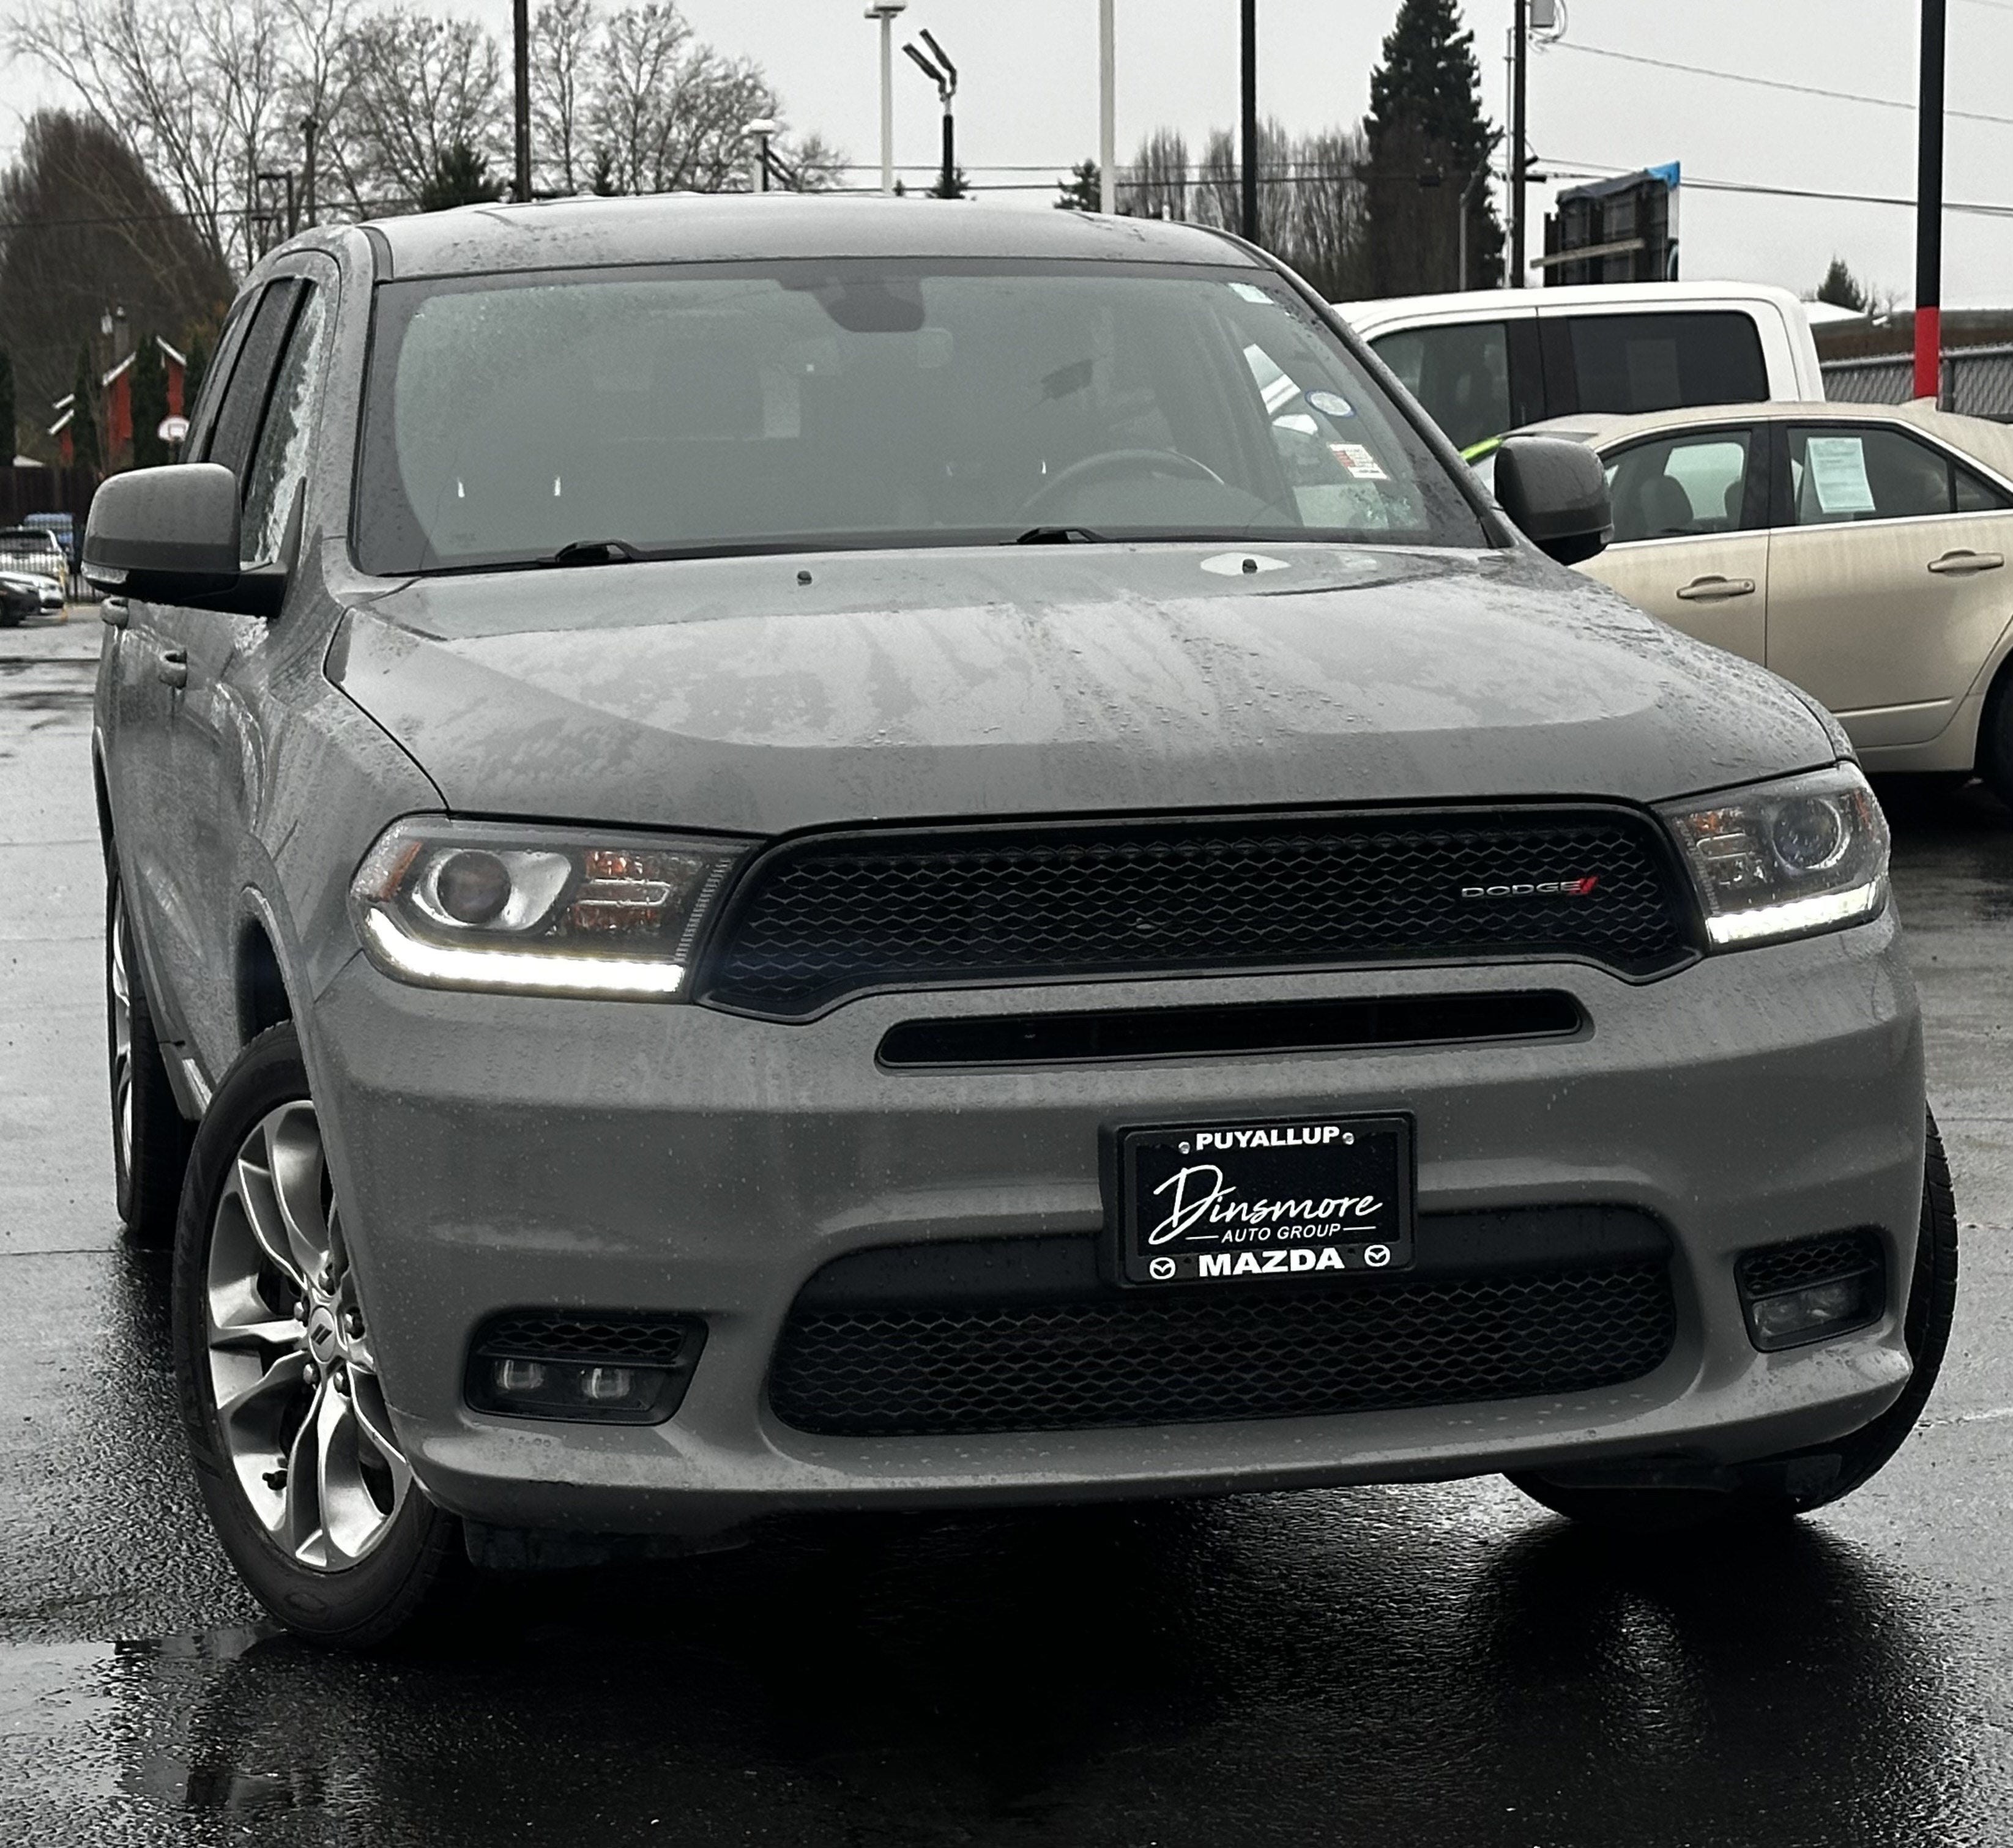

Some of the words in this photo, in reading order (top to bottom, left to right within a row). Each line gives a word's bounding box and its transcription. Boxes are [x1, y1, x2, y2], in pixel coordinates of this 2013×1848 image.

[1462, 880, 1581, 897] DODGE
[1196, 1126, 1341, 1151] PUYALLUP
[1148, 1164, 1383, 1245] Dinsmore
[1221, 1227, 1271, 1243] AUTO
[1276, 1223, 1341, 1240] GROUP
[1199, 1247, 1345, 1277] MAZDA
